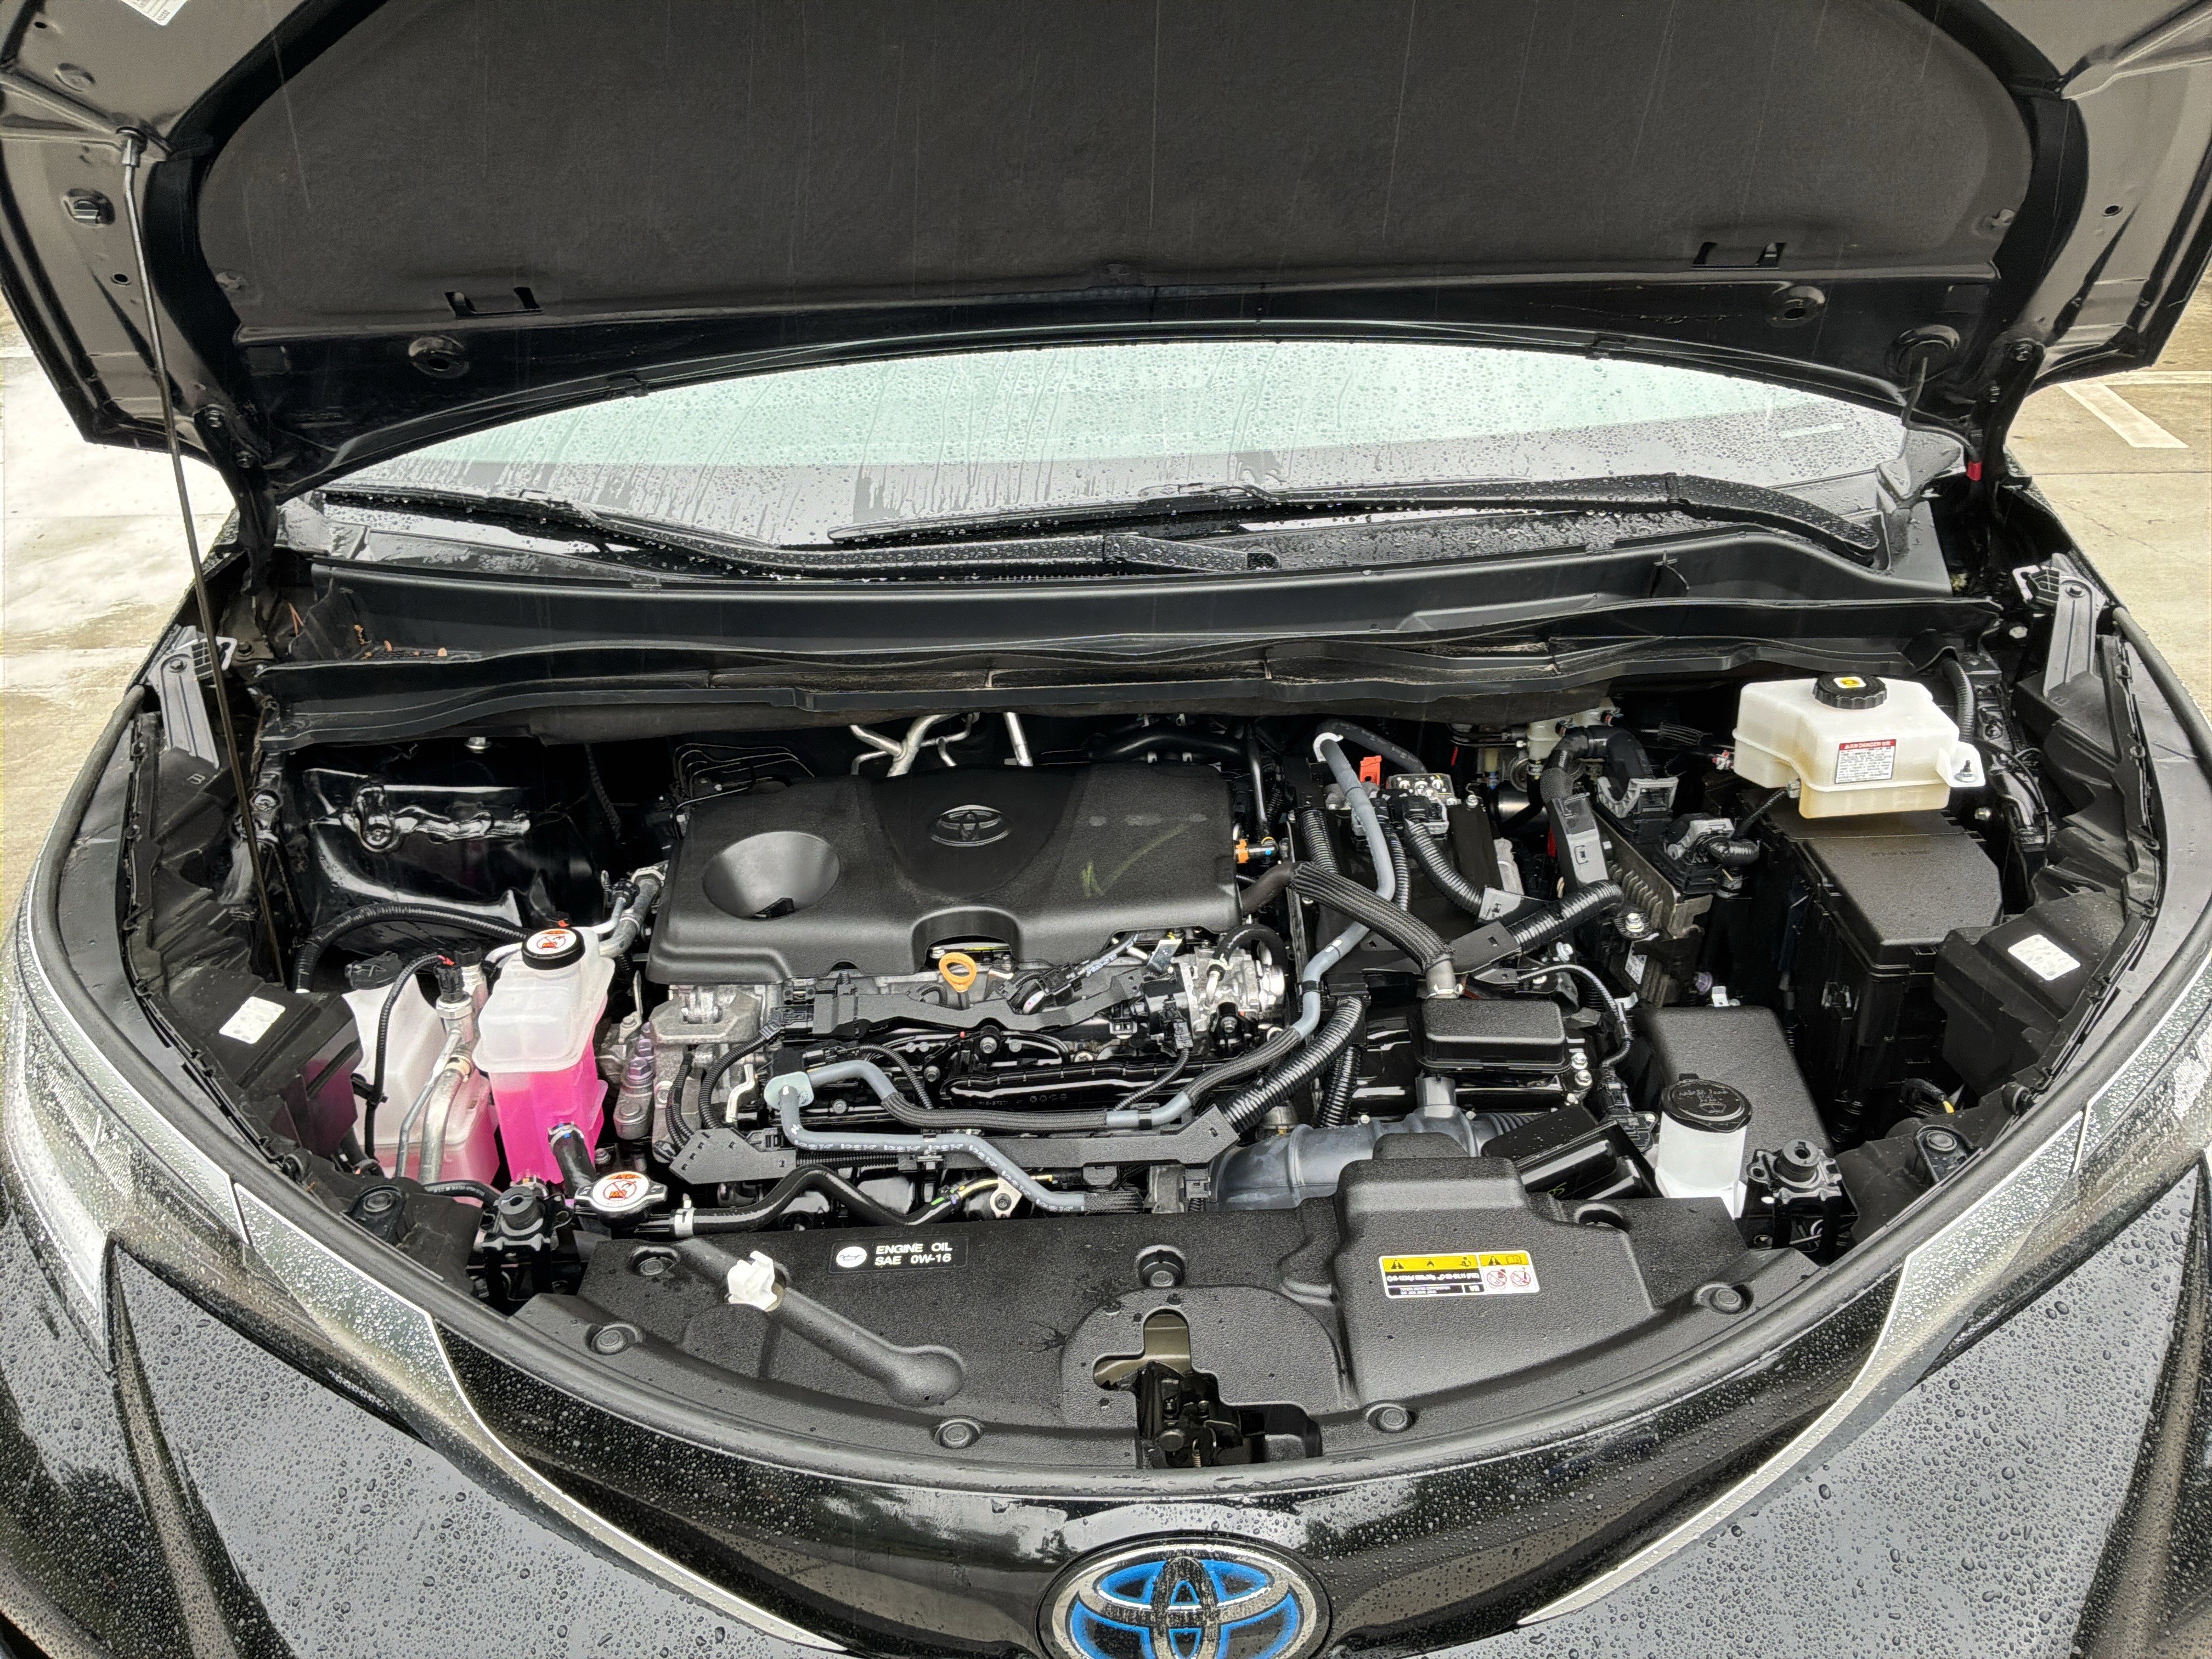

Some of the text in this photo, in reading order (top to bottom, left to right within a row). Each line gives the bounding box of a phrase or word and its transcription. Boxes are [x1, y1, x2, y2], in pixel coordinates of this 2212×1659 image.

[876, 1242, 952, 1255] ENGINE OIL
[874, 1254, 951, 1266] SAE 0W-16
